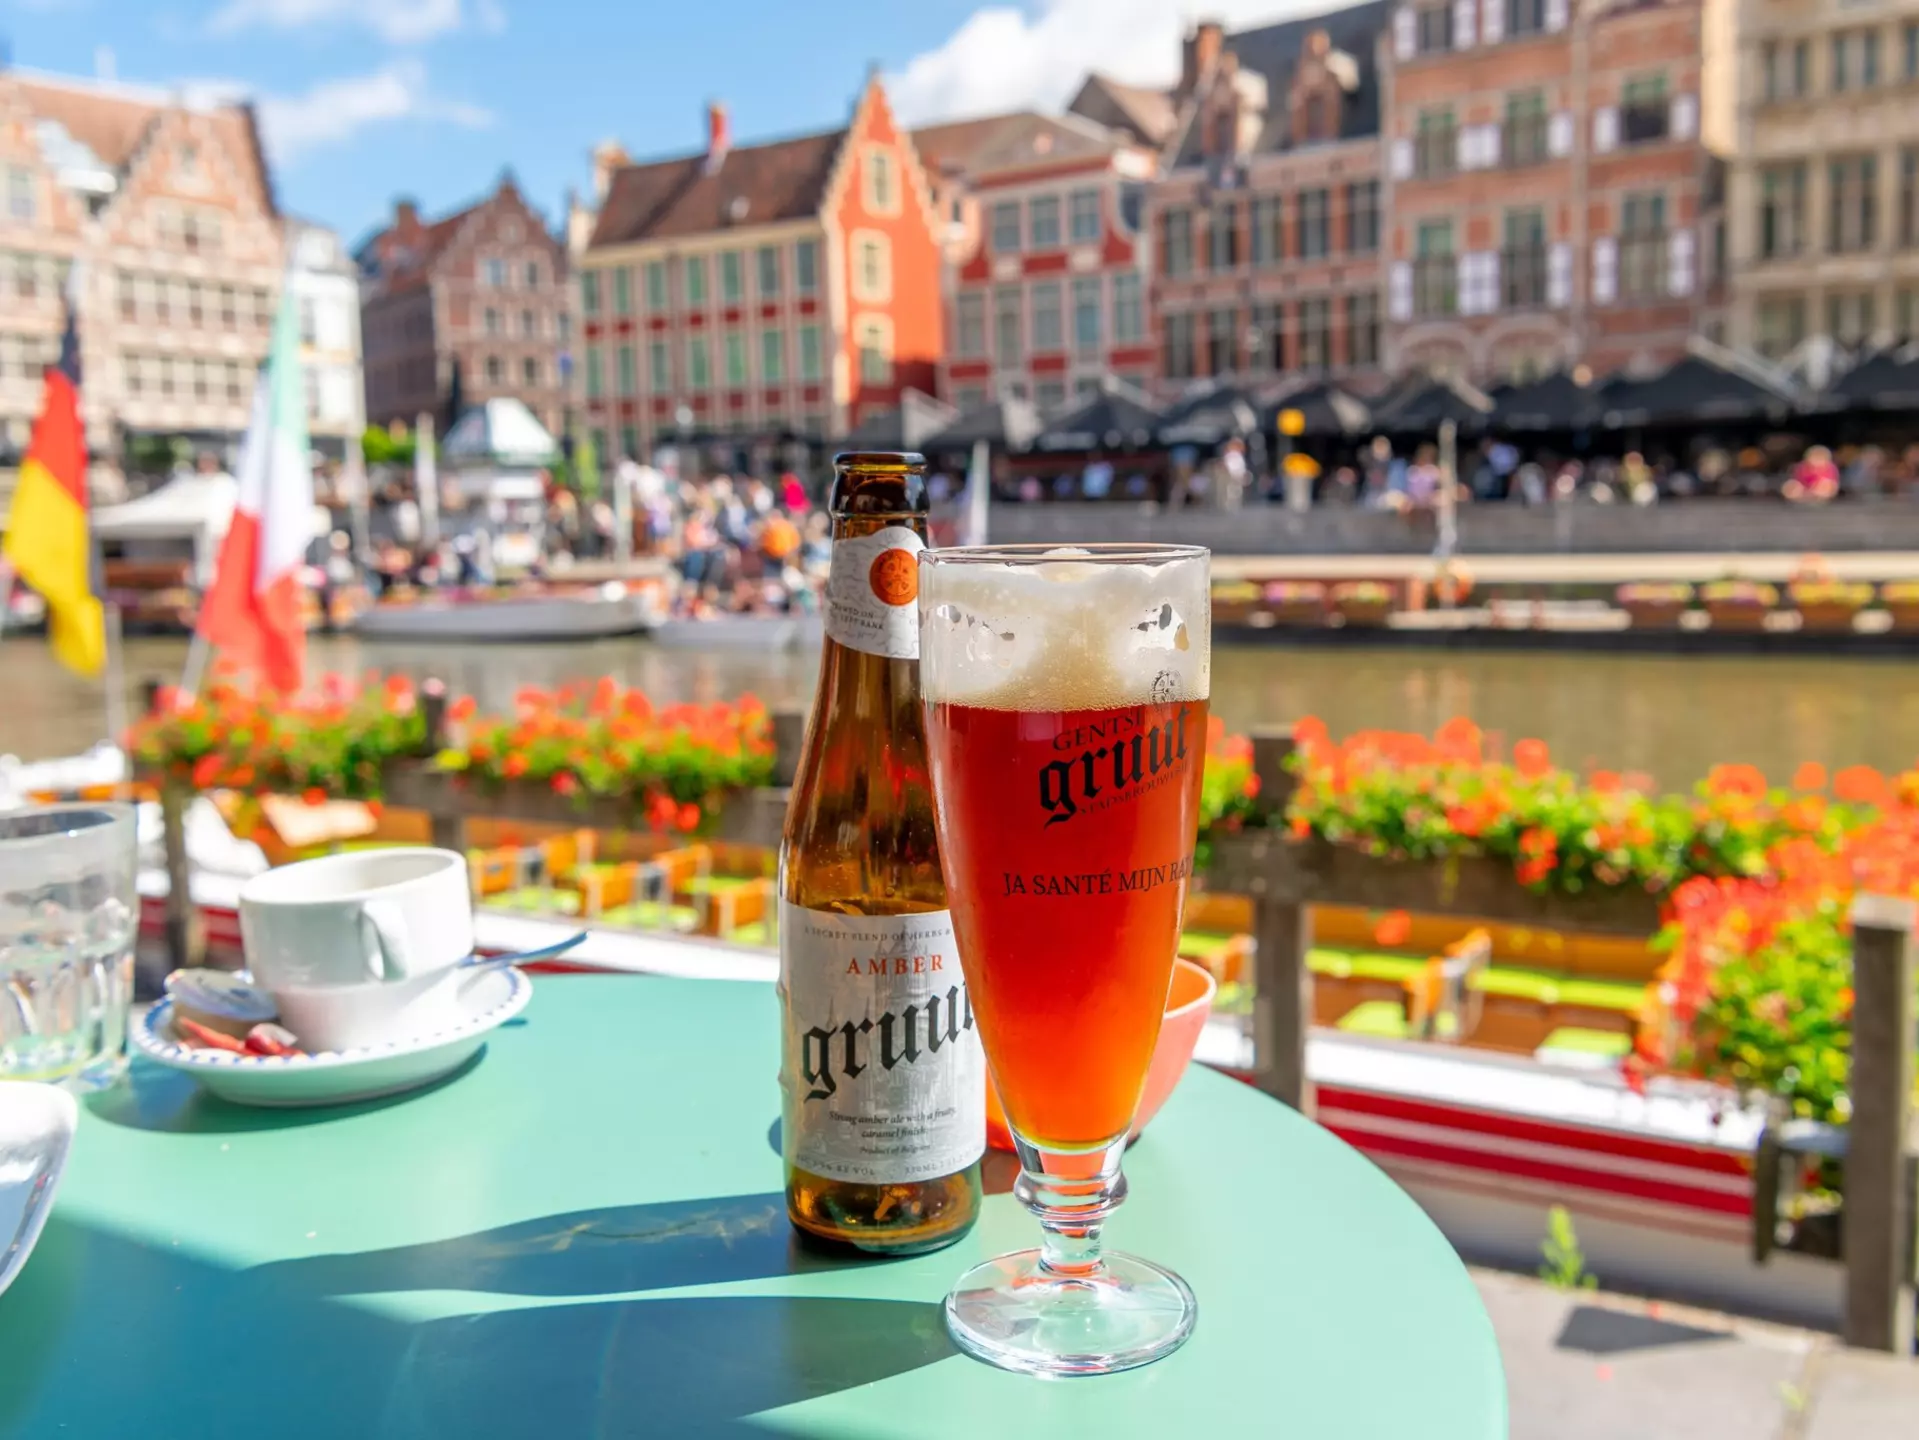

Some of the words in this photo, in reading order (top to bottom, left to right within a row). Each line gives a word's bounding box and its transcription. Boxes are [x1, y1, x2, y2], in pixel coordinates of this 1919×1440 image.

[860, 619, 884, 630] BANK
[1039, 703, 1190, 830] gruut
[1003, 871, 1027, 896] JA
[1033, 867, 1113, 895] SANTÉ
[1118, 864, 1167, 892] MIJN
[851, 931, 887, 941] BLEND
[846, 954, 943, 976] AMBER
[829, 1110, 858, 1125] Strong
[858, 1114, 889, 1124] amber
[890, 1113, 905, 1124] ale
[861, 1126, 899, 1138] caramel
